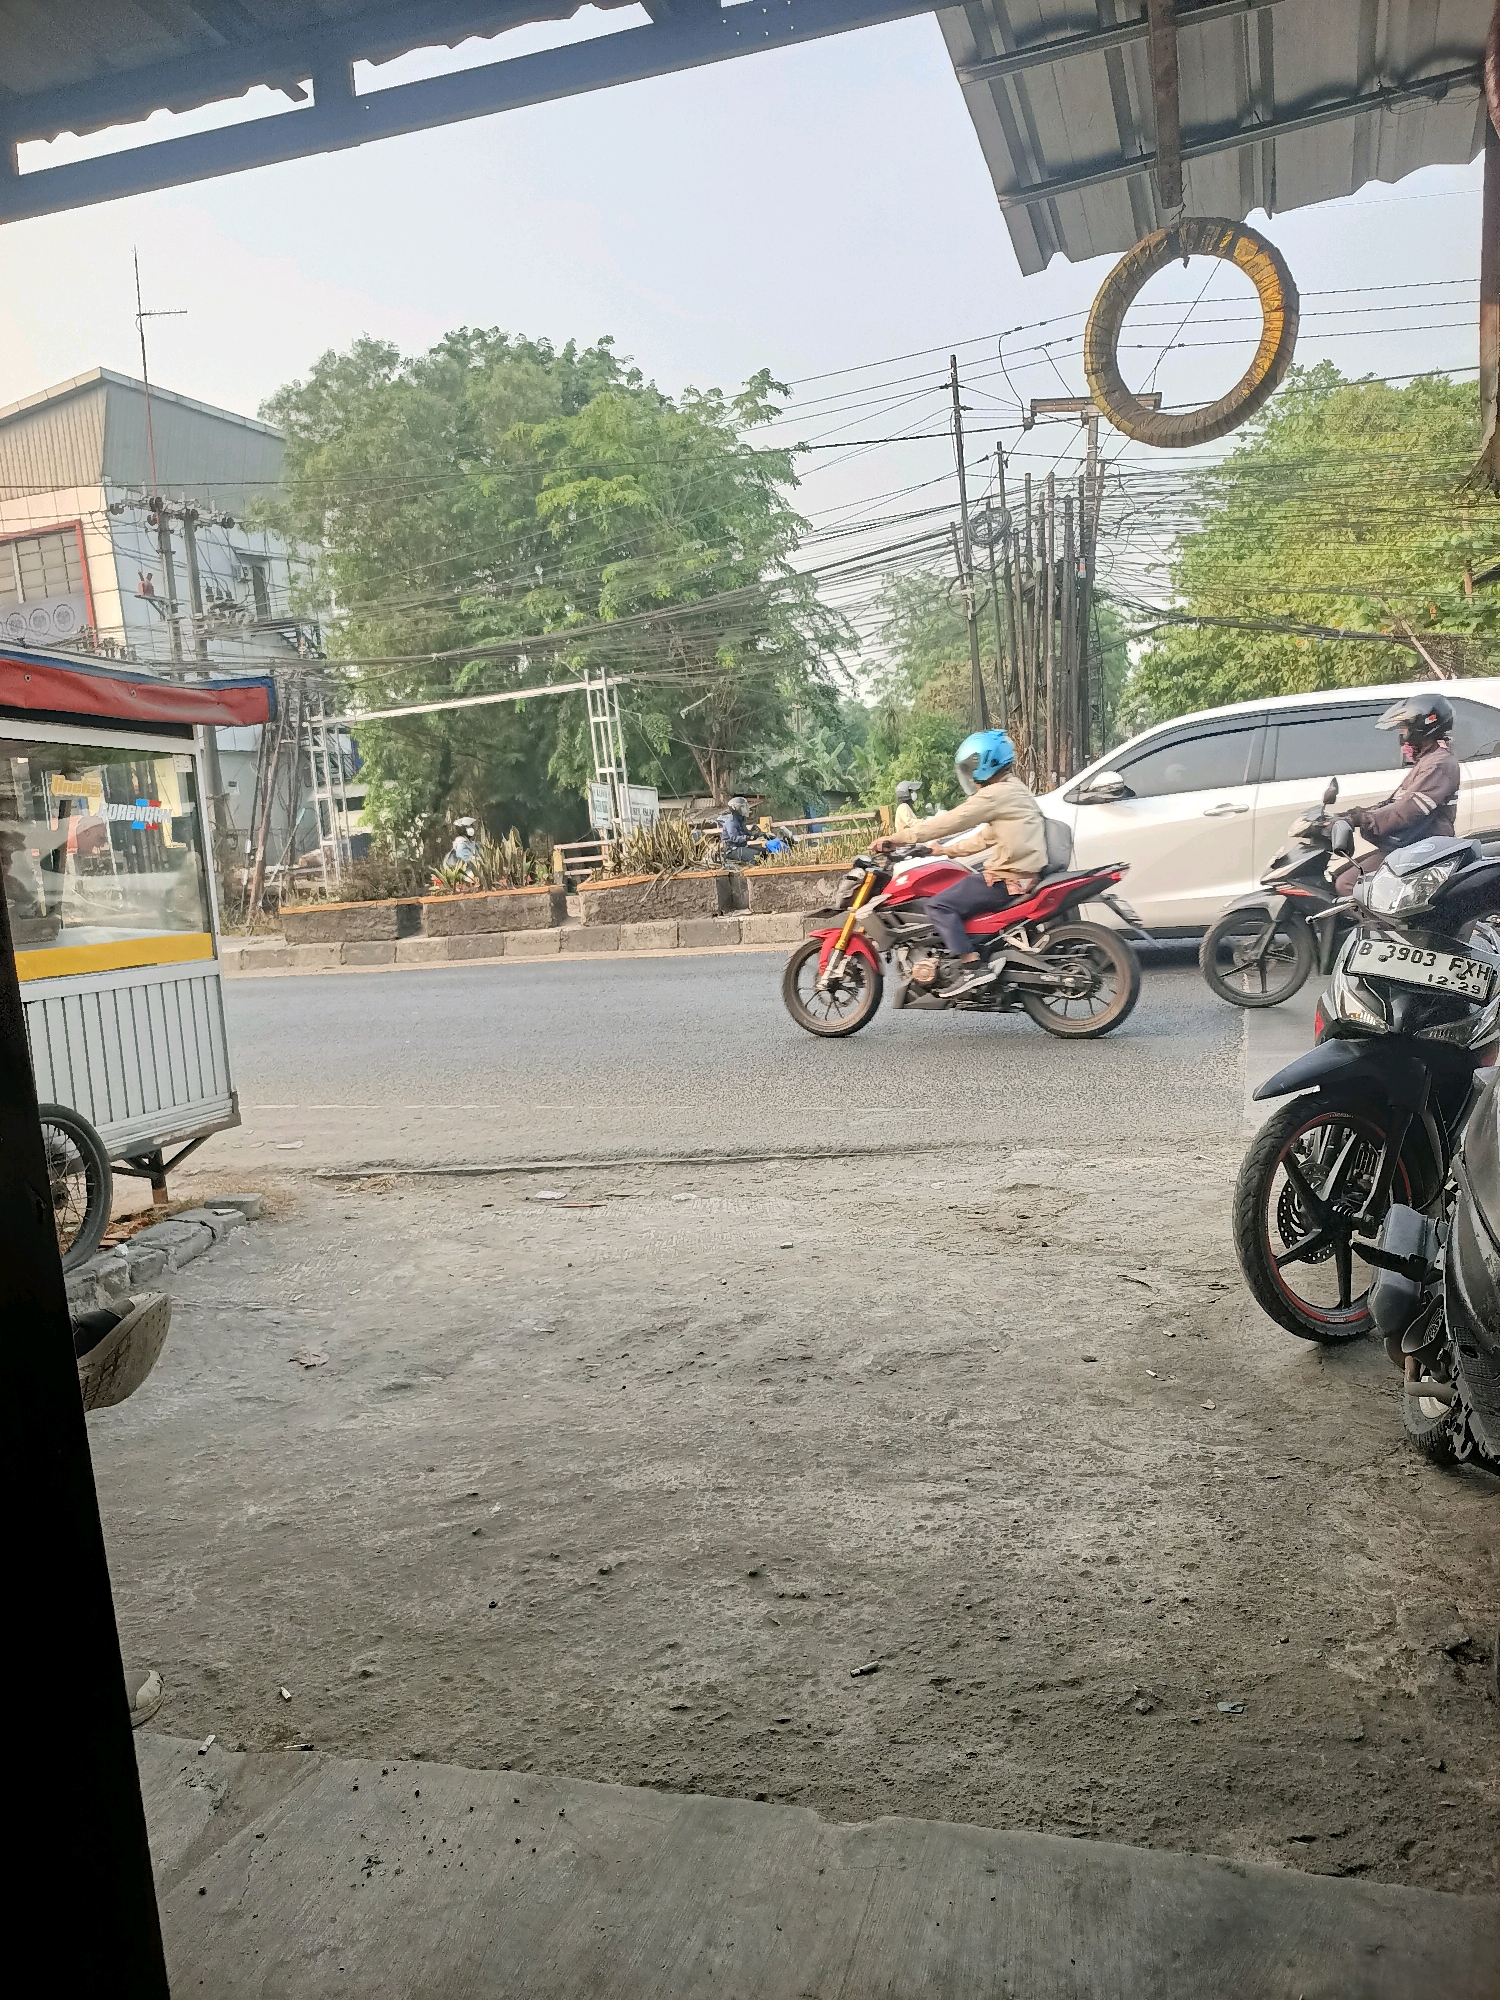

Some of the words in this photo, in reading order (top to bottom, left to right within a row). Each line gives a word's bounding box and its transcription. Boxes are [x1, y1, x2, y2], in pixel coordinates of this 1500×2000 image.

[1359, 942, 1373, 955] B
[1378, 944, 1437, 966] 3903
[1448, 957, 1491, 980] FXH
